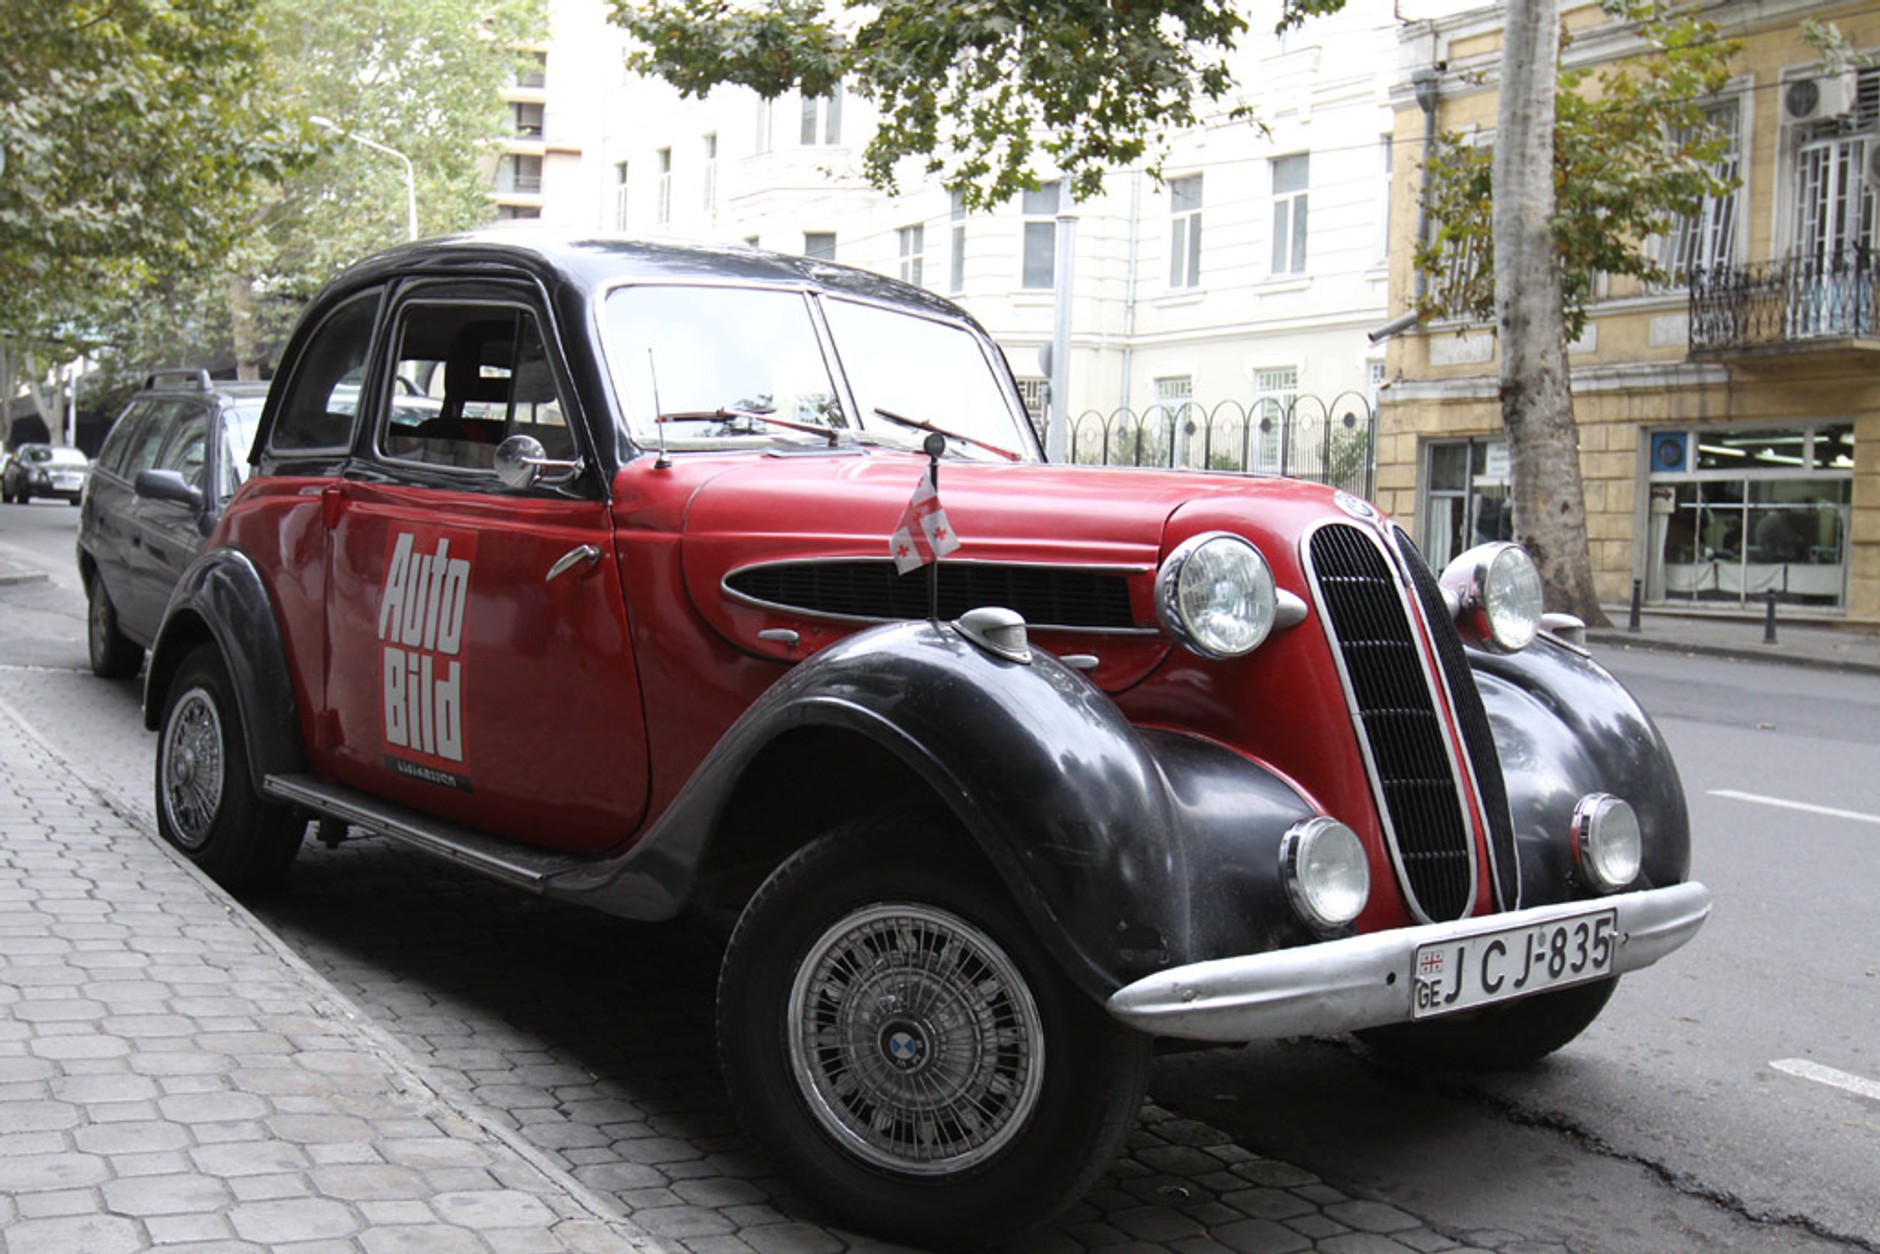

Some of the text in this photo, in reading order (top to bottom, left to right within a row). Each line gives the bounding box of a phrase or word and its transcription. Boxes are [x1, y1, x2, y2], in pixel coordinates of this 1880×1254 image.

[378, 532, 470, 655] Auto
[383, 646, 463, 762] Bild
[1417, 979, 1442, 1009] GE
